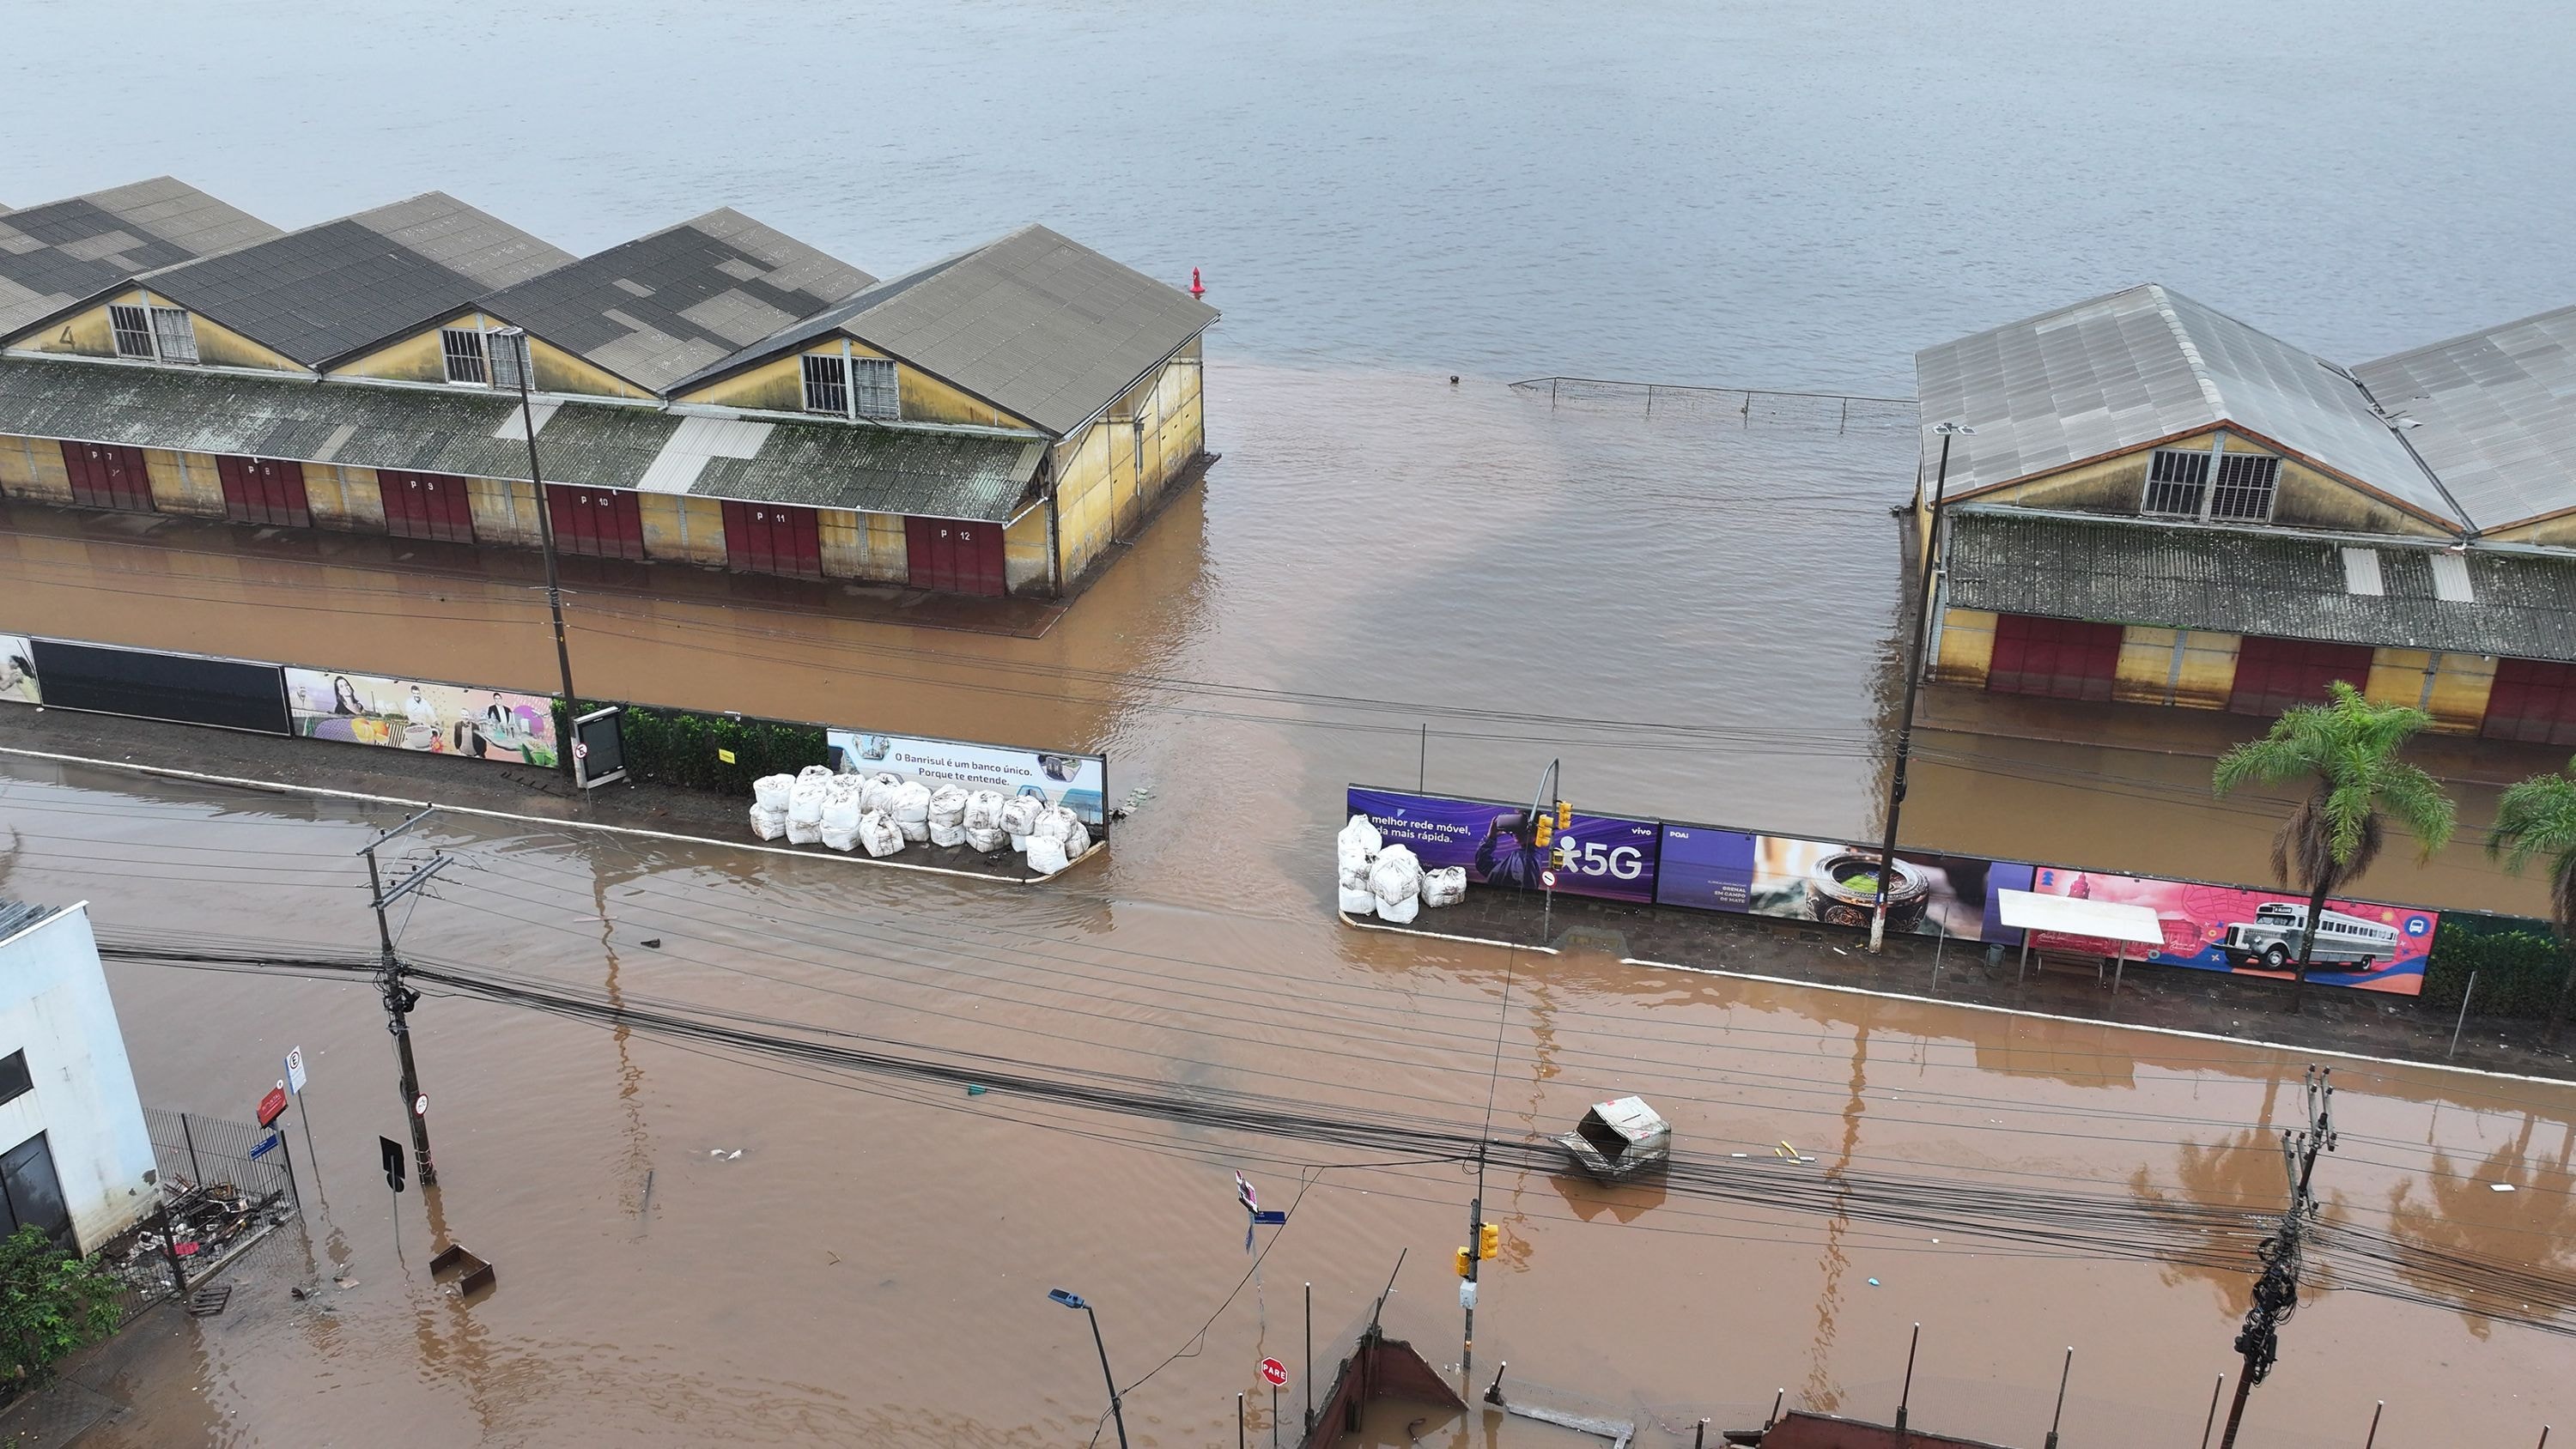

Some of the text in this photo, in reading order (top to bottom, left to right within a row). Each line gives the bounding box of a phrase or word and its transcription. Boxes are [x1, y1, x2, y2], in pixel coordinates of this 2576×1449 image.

[59, 326, 76, 350] 4
[599, 498, 608, 506] 10
[776, 514, 785, 522] 11
[960, 532, 970, 540] 12
[895, 753, 902, 761] O
[904, 754, 945, 766] Banrisul
[972, 761, 1001, 772] banco
[1004, 765, 1032, 776] único.
[919, 768, 1009, 786] Porque te entende.
[1372, 816, 1471, 836] melhor rede móvel,
[1631, 827, 1651, 835] vivo
[1391, 829, 1415, 838] mais
[1417, 831, 1453, 843] rápida.
[1581, 842, 1642, 880] 5G
[1263, 1364, 1285, 1380] PARE
